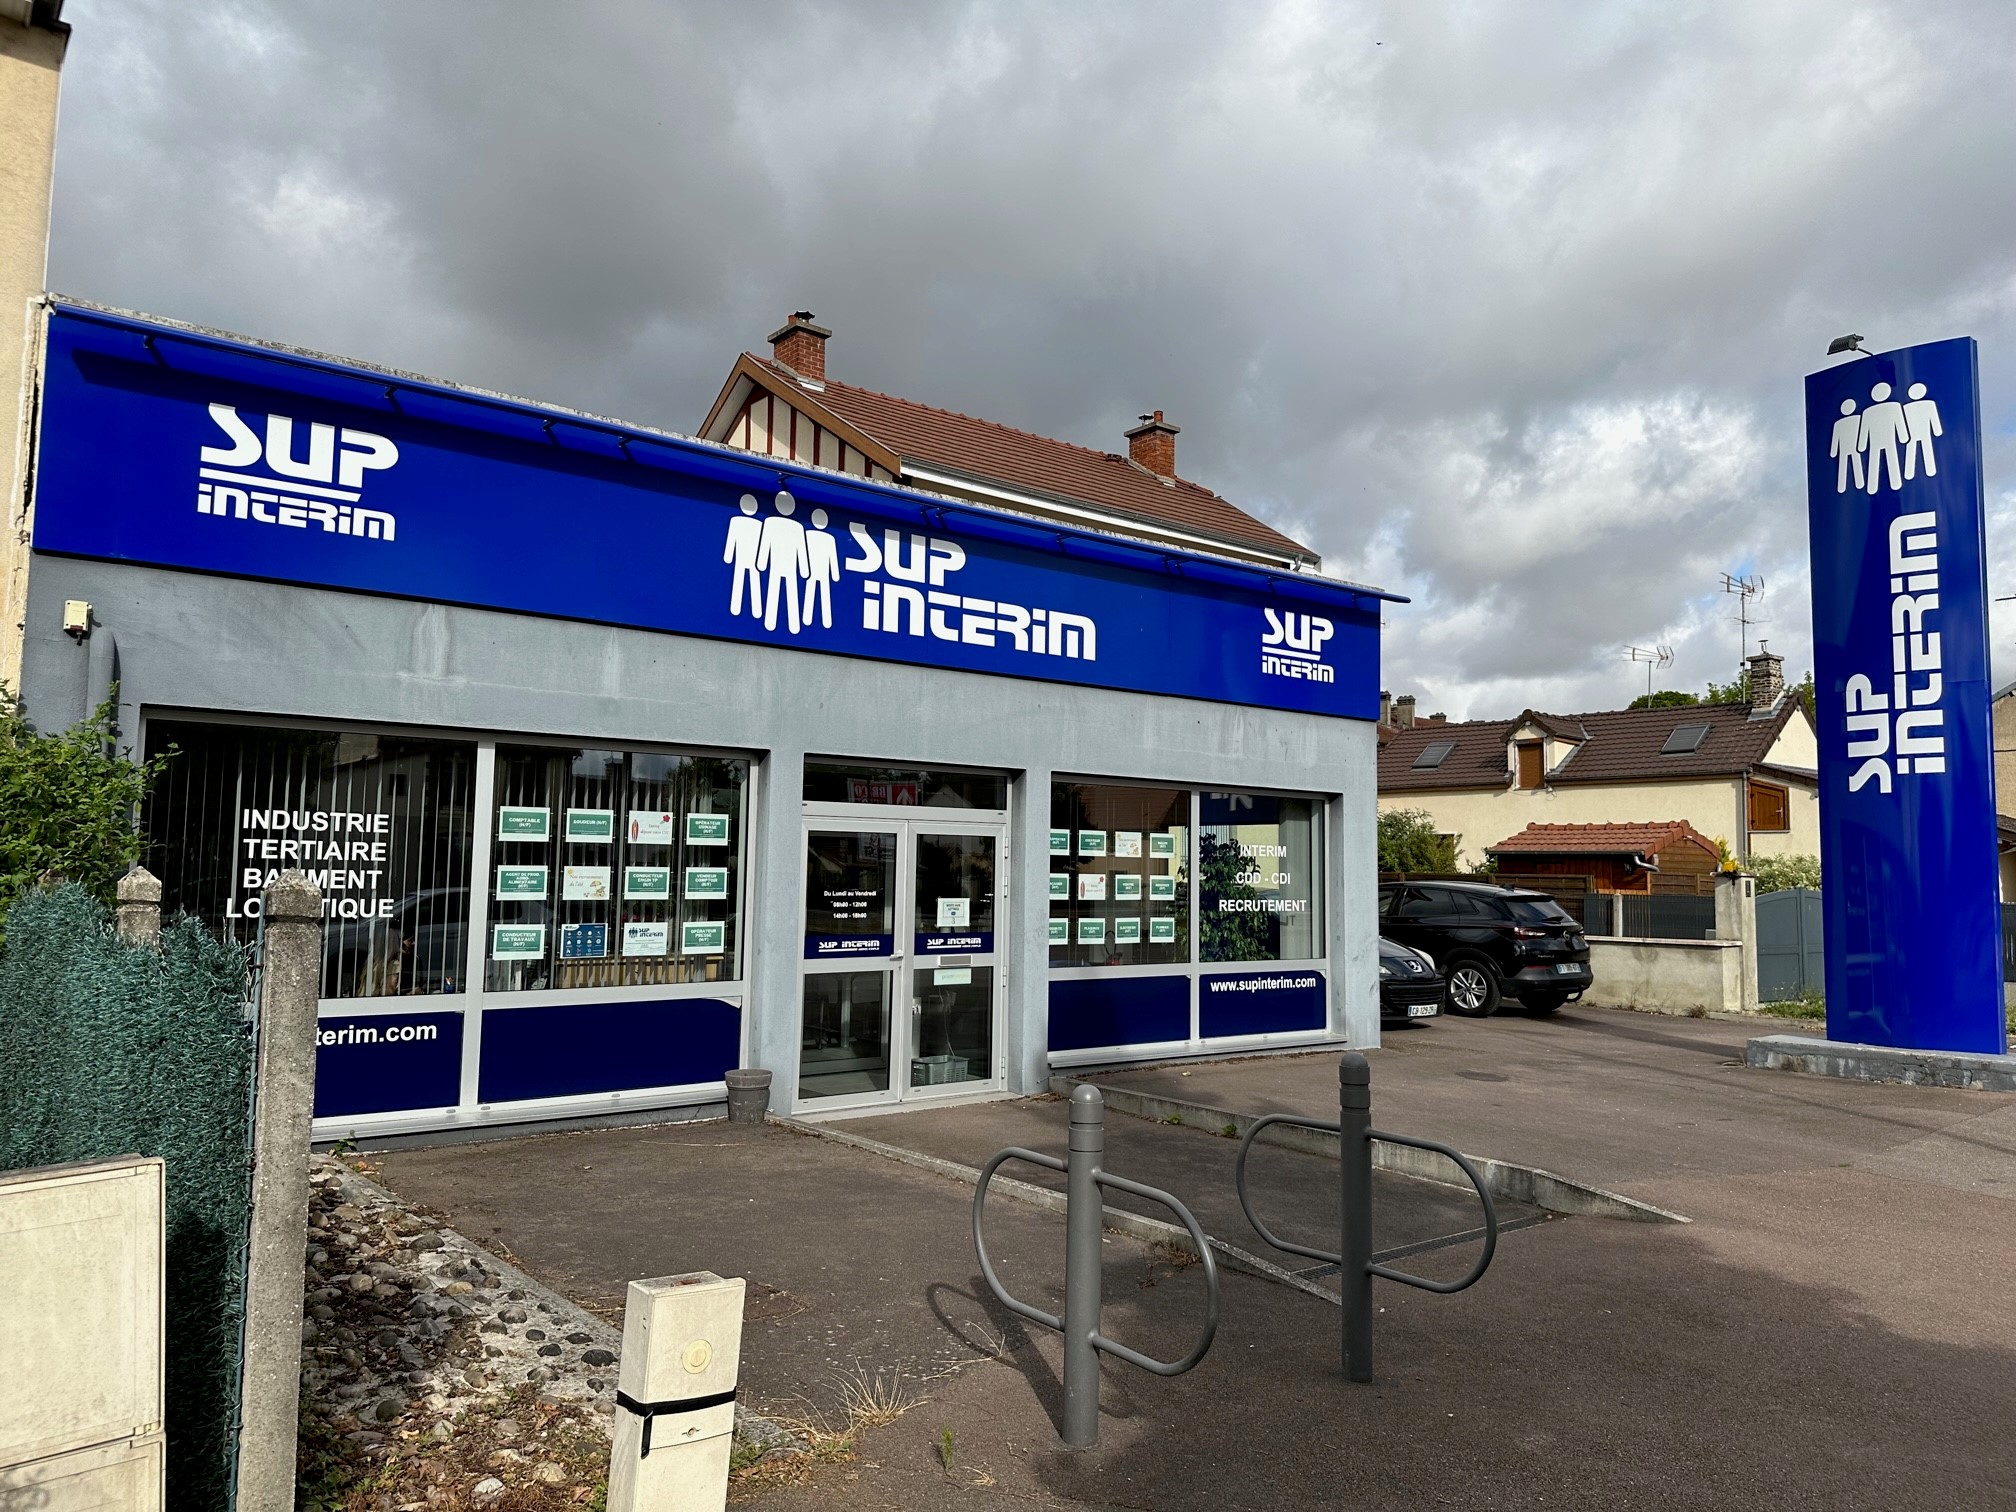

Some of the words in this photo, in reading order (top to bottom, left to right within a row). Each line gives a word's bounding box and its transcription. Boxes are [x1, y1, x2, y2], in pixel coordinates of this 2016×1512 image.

[200, 402, 399, 488] SUP
[845, 521, 967, 587] SUP
[1261, 607, 1335, 652] SUP
[1845, 673, 1893, 794] SUP
[242, 808, 390, 834] INDUSTRIE
[242, 838, 388, 862] TERTIAIRE
[1239, 844, 1287, 858] INTERIM
[243, 868, 382, 889] BAMENT
[1235, 872, 1262, 885] CDD
[1271, 872, 1291, 885] CDI
[226, 898, 395, 919] LOTIQUE
[1218, 899, 1307, 913] RECRUTEMENT
[818, 941, 838, 949] SUP
[926, 938, 945, 946] SUP
[1210, 976, 1316, 993] www.supinterim.com
